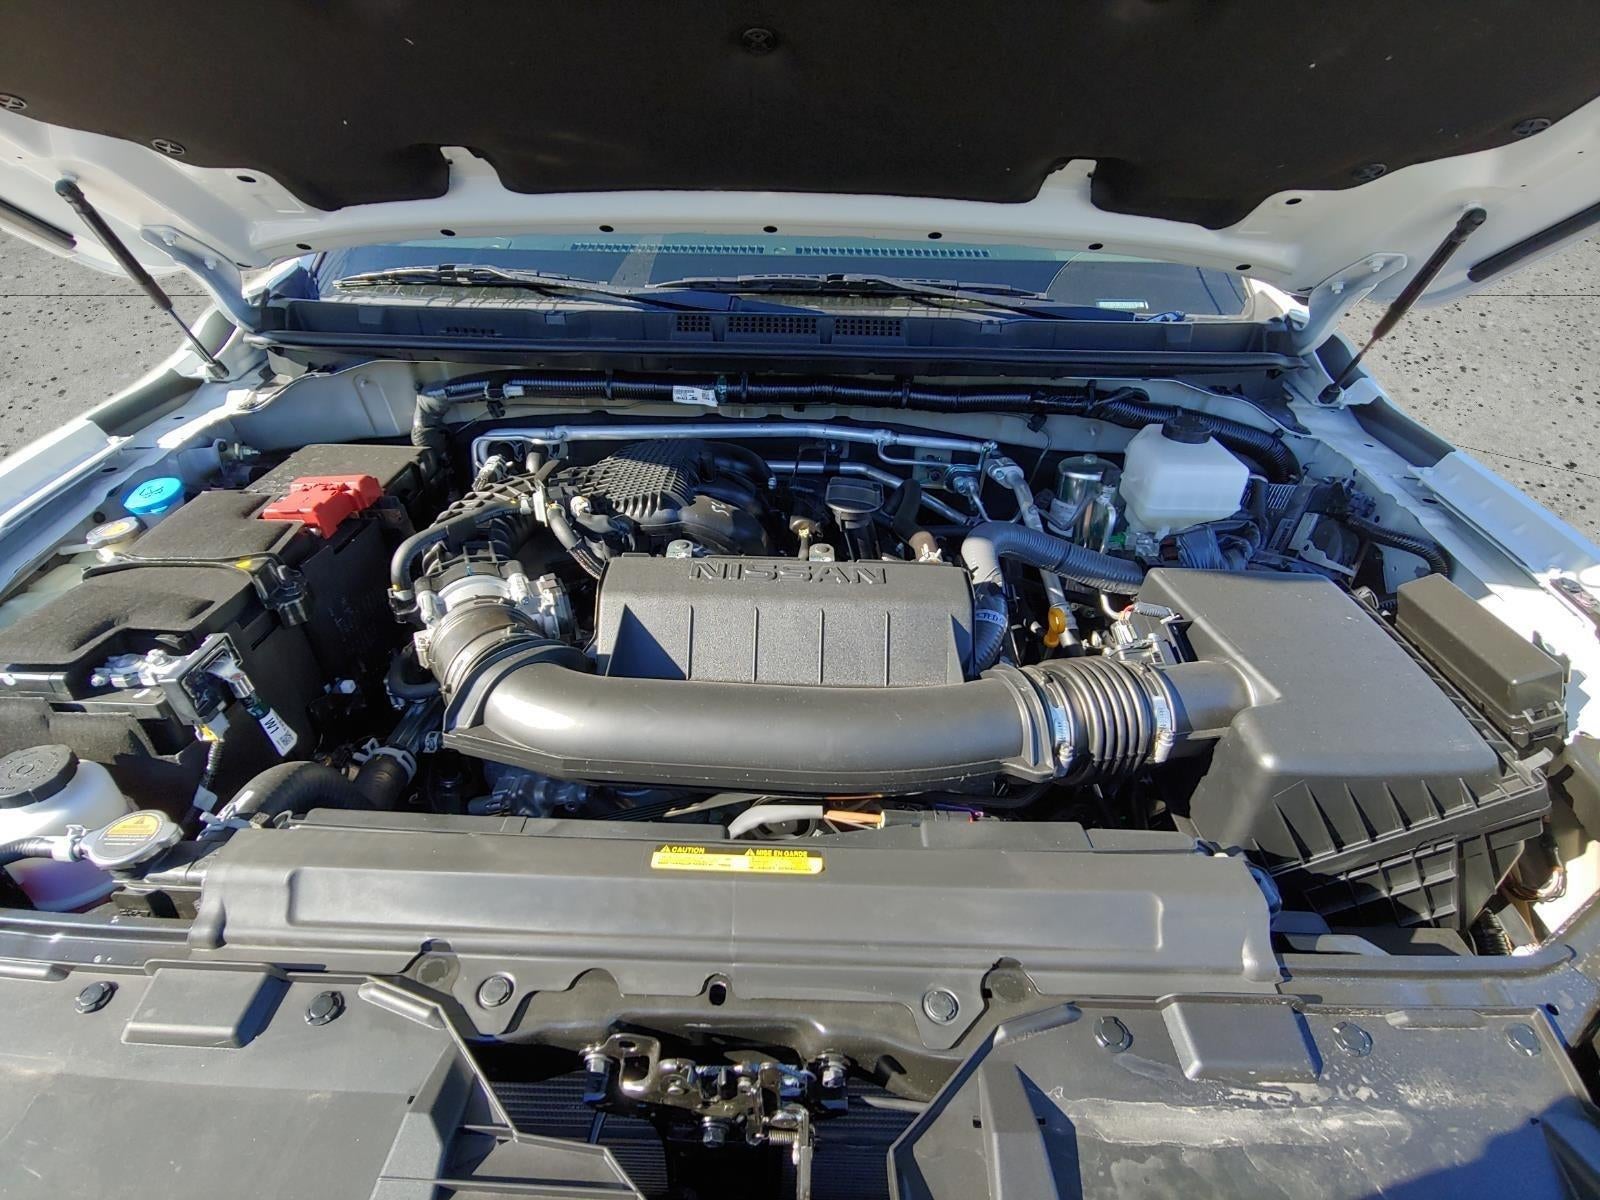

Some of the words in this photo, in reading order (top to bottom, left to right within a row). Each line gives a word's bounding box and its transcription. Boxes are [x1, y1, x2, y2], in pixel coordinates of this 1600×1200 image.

[688, 560, 887, 584] NISSAN
[671, 846, 705, 854] CAUTION
[755, 849, 772, 857] MISE
[784, 850, 808, 858] GARDE
